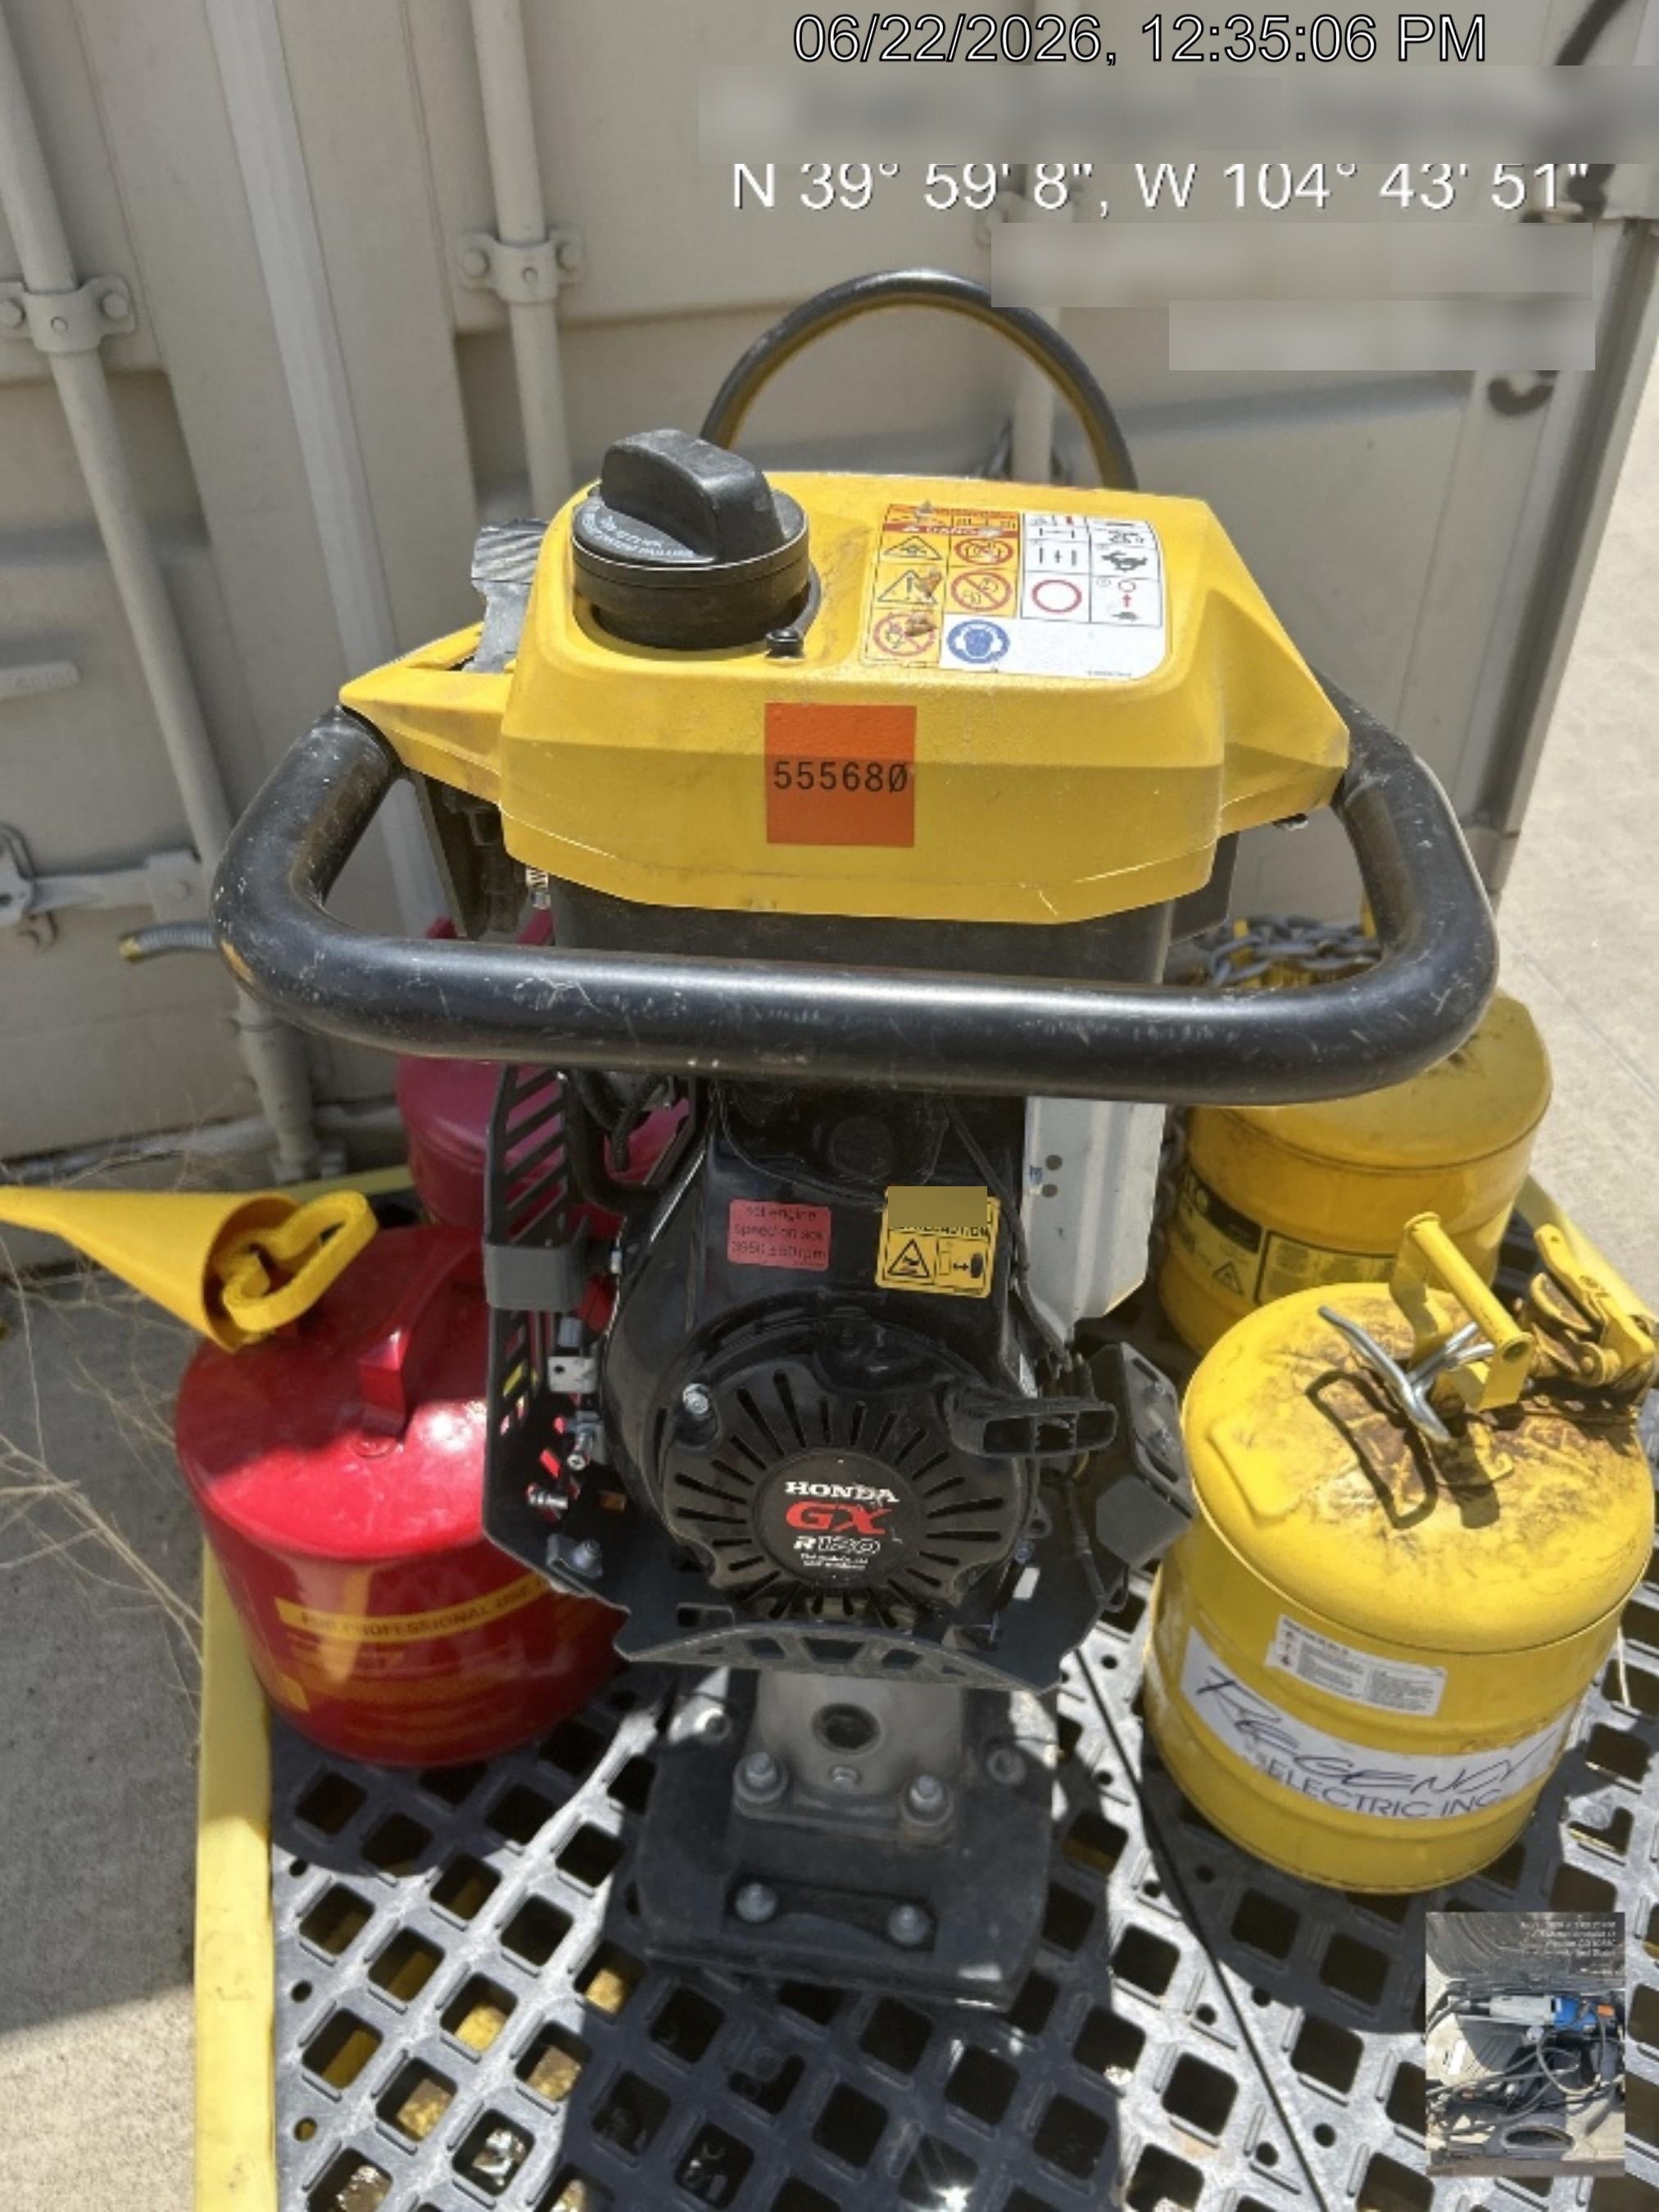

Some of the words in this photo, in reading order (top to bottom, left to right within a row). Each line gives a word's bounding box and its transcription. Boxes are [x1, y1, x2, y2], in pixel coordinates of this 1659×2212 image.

[773, 759, 908, 794] 555680
[784, 1480, 900, 1504] HONDA
[785, 1500, 893, 1535] GX
[1267, 1757, 1432, 1819] ELECTRIC
